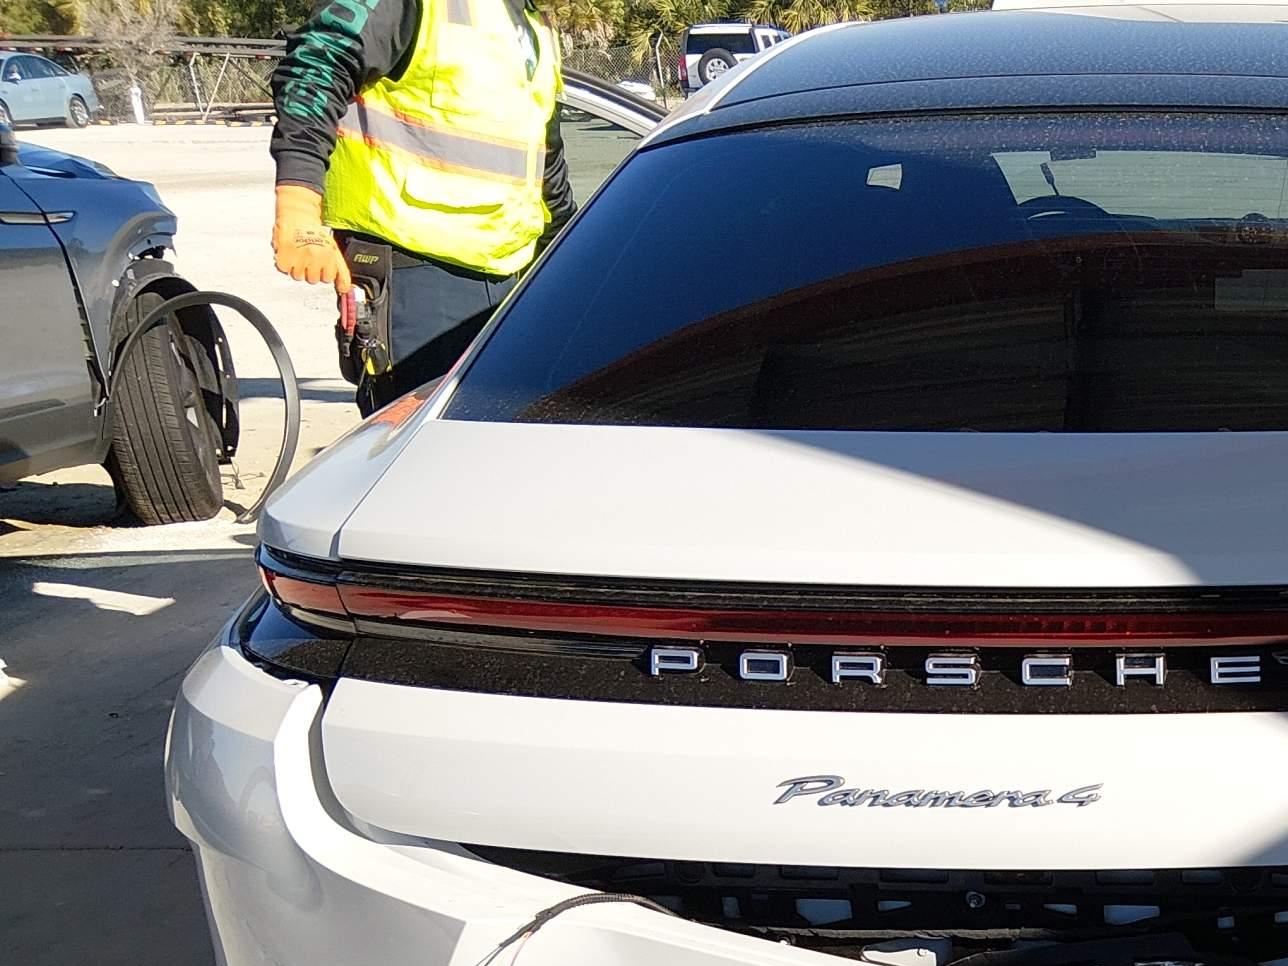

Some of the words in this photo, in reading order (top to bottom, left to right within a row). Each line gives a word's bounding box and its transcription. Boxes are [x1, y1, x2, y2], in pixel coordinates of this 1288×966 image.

[650, 648, 1261, 687] PORSCHE
[772, 774, 1055, 807] Panamera
[1056, 783, 1104, 806] 4
